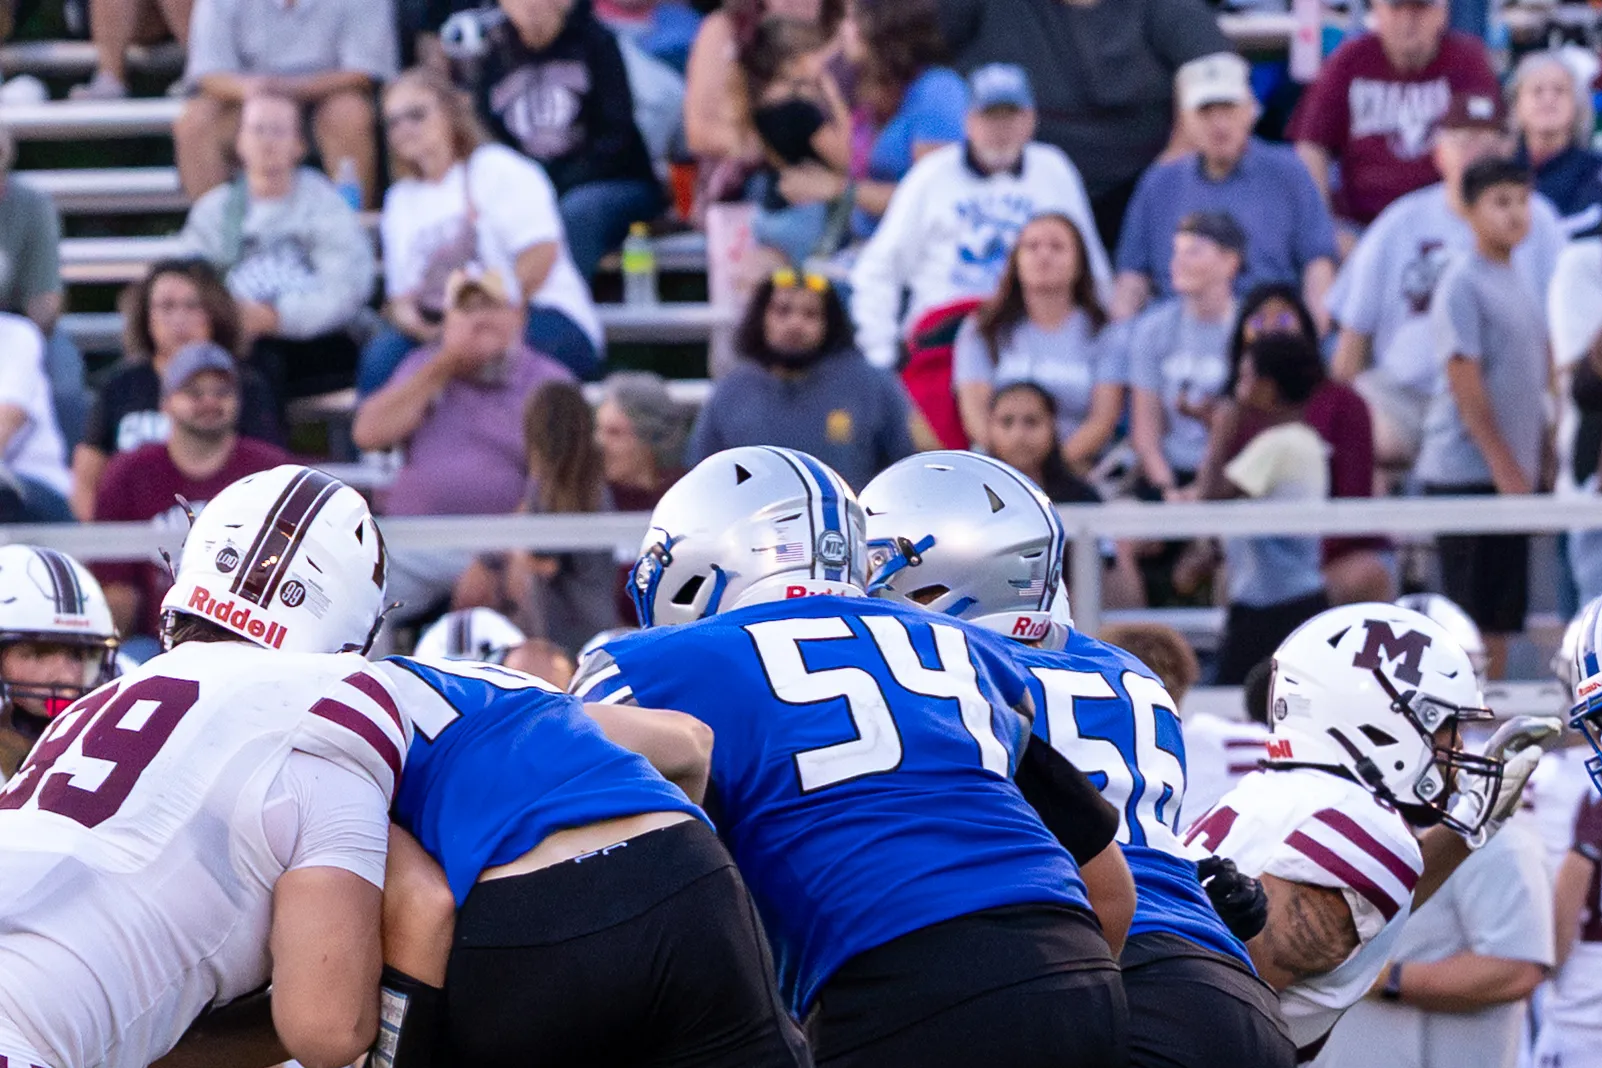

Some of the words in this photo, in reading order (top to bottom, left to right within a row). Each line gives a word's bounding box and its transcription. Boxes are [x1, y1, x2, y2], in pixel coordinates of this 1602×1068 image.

[187, 585, 288, 650] Riddell
[281, 581, 304, 606] 99
[1352, 619, 1432, 687] M
[744, 615, 1009, 793] 54
[1029, 666, 1192, 862] 56
